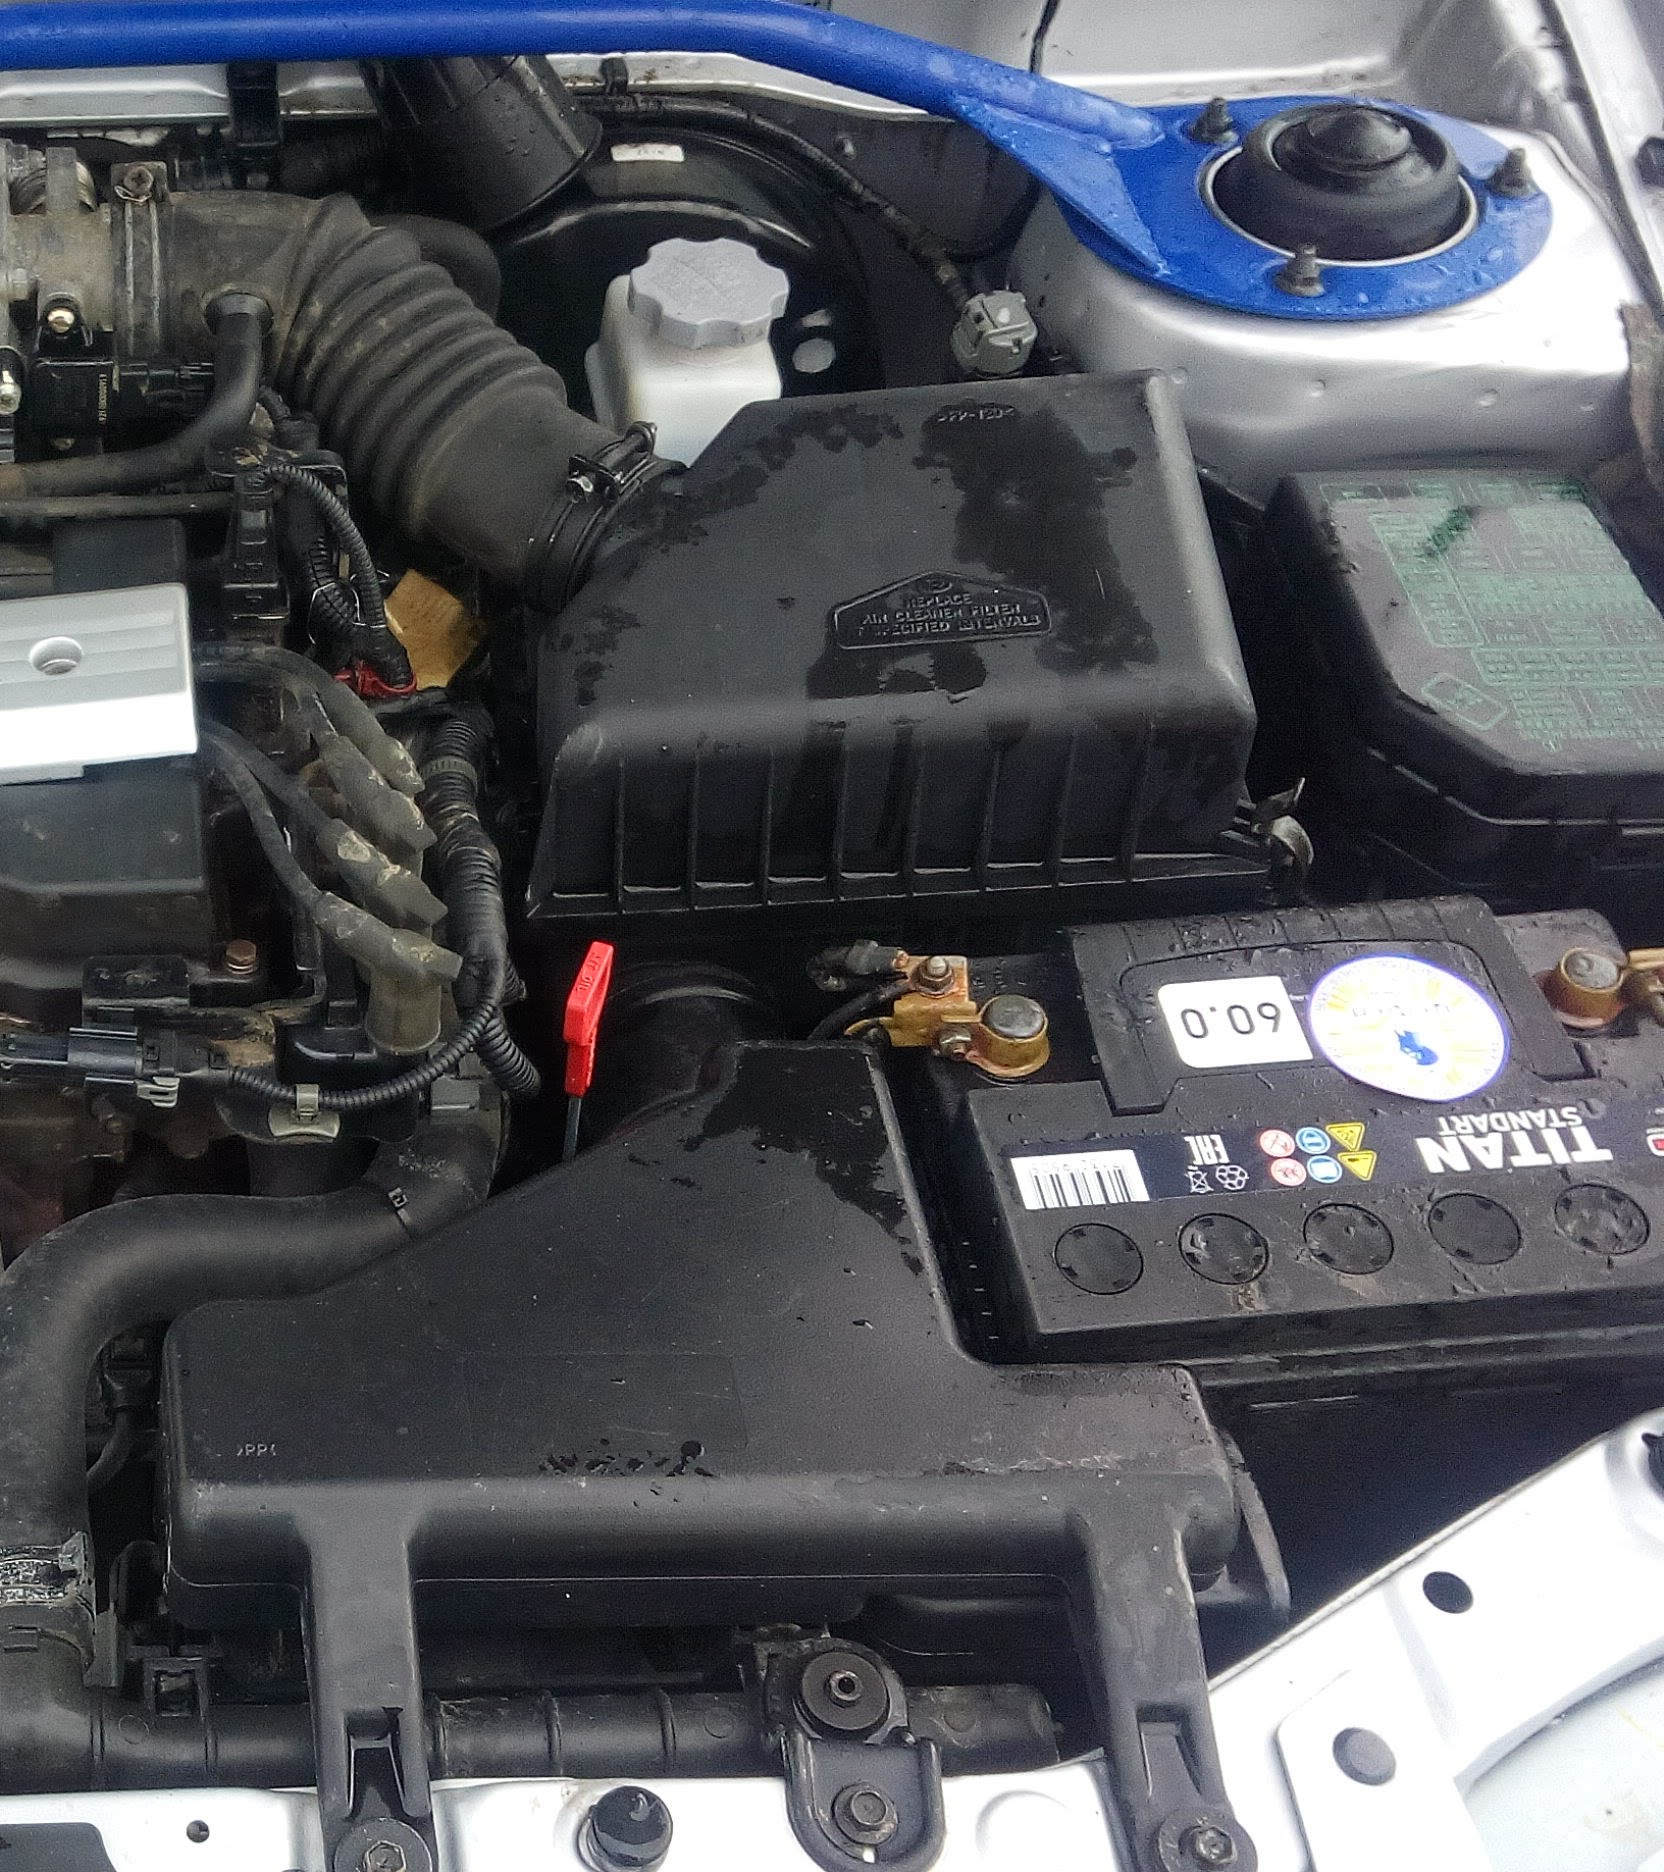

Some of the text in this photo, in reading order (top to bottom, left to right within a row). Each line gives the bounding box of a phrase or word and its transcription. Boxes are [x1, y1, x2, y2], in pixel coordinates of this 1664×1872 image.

[971, 603, 1021, 617] FILTER
[1180, 1002, 1281, 1040] 60.0
[1435, 1105, 1583, 1137] STANDART
[1414, 1125, 1614, 1174] TITAN
